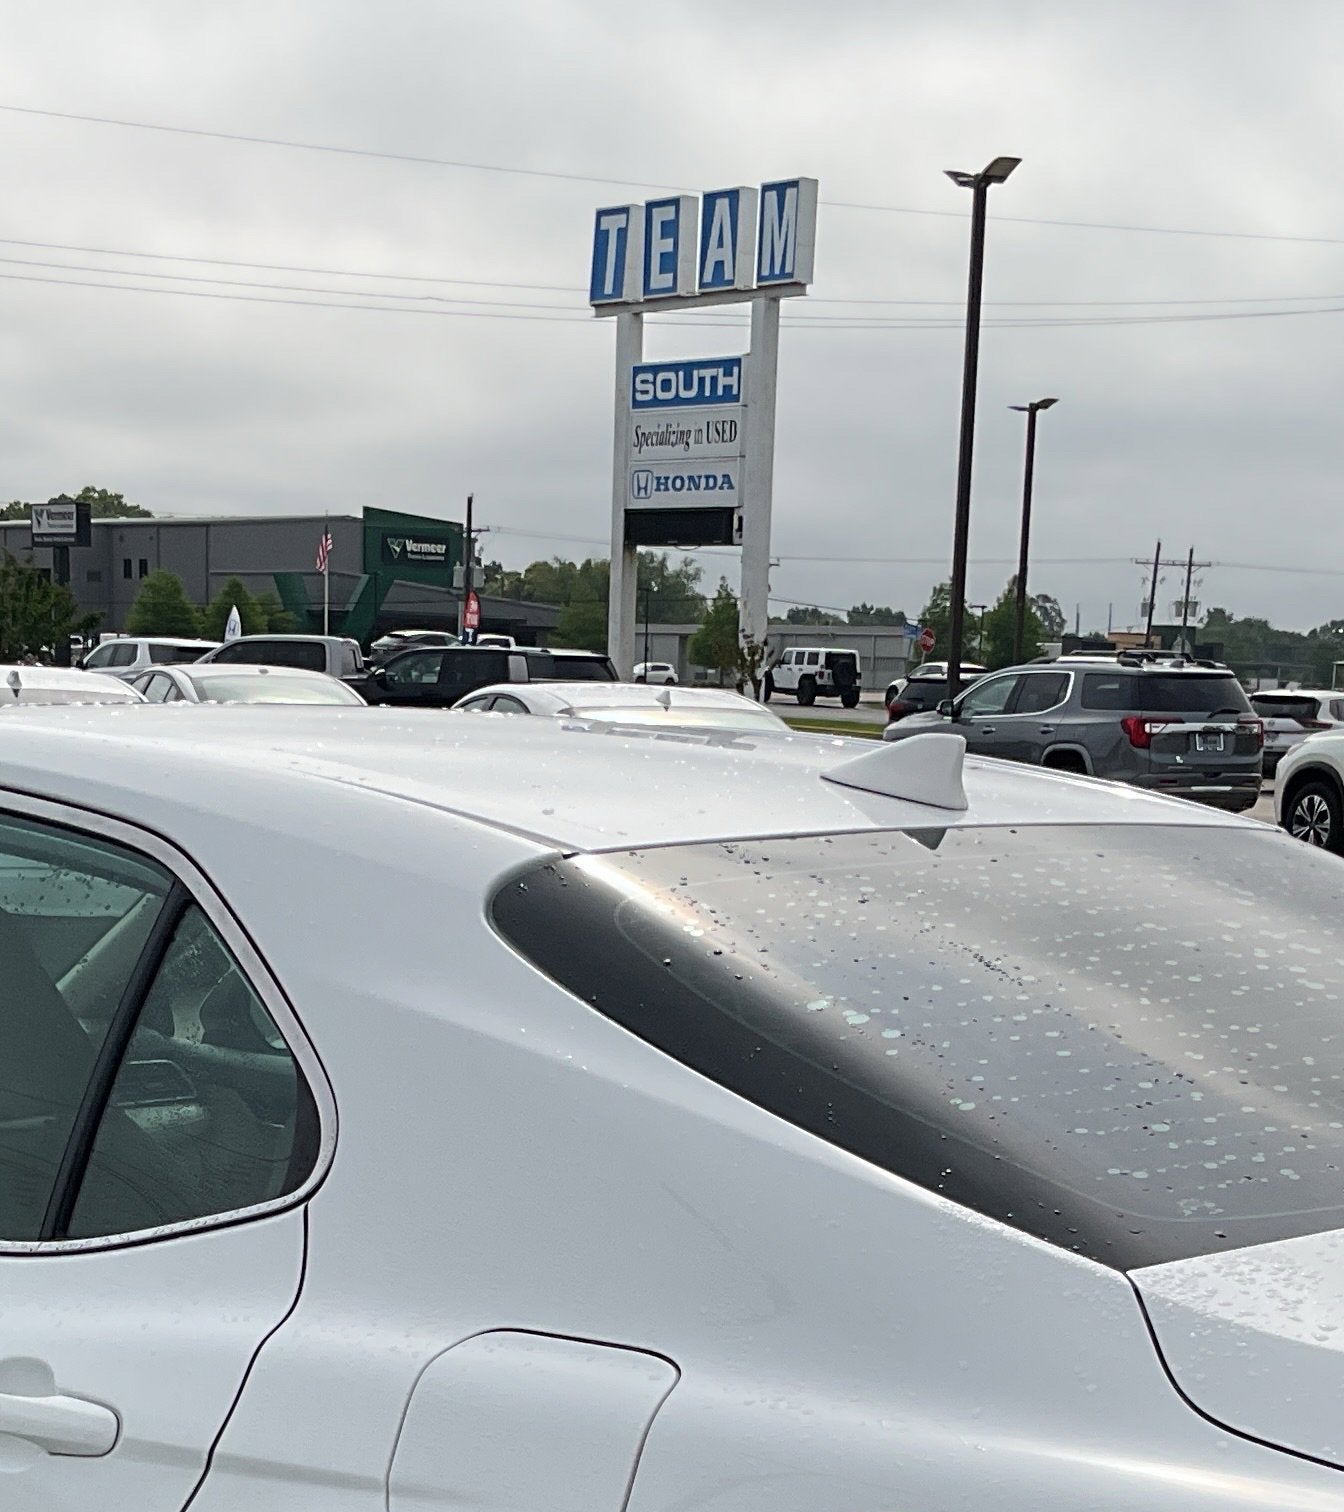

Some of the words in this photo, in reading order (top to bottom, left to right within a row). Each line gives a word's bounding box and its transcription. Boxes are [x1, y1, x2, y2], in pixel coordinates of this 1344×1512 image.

[599, 188, 798, 296] TEAM
[635, 366, 739, 401] SOUTH
[633, 423, 692, 454] Specializing
[694, 428, 703, 444] in
[706, 420, 738, 444] USED
[654, 473, 735, 492] HONDA
[405, 539, 446, 554] Vermeer
